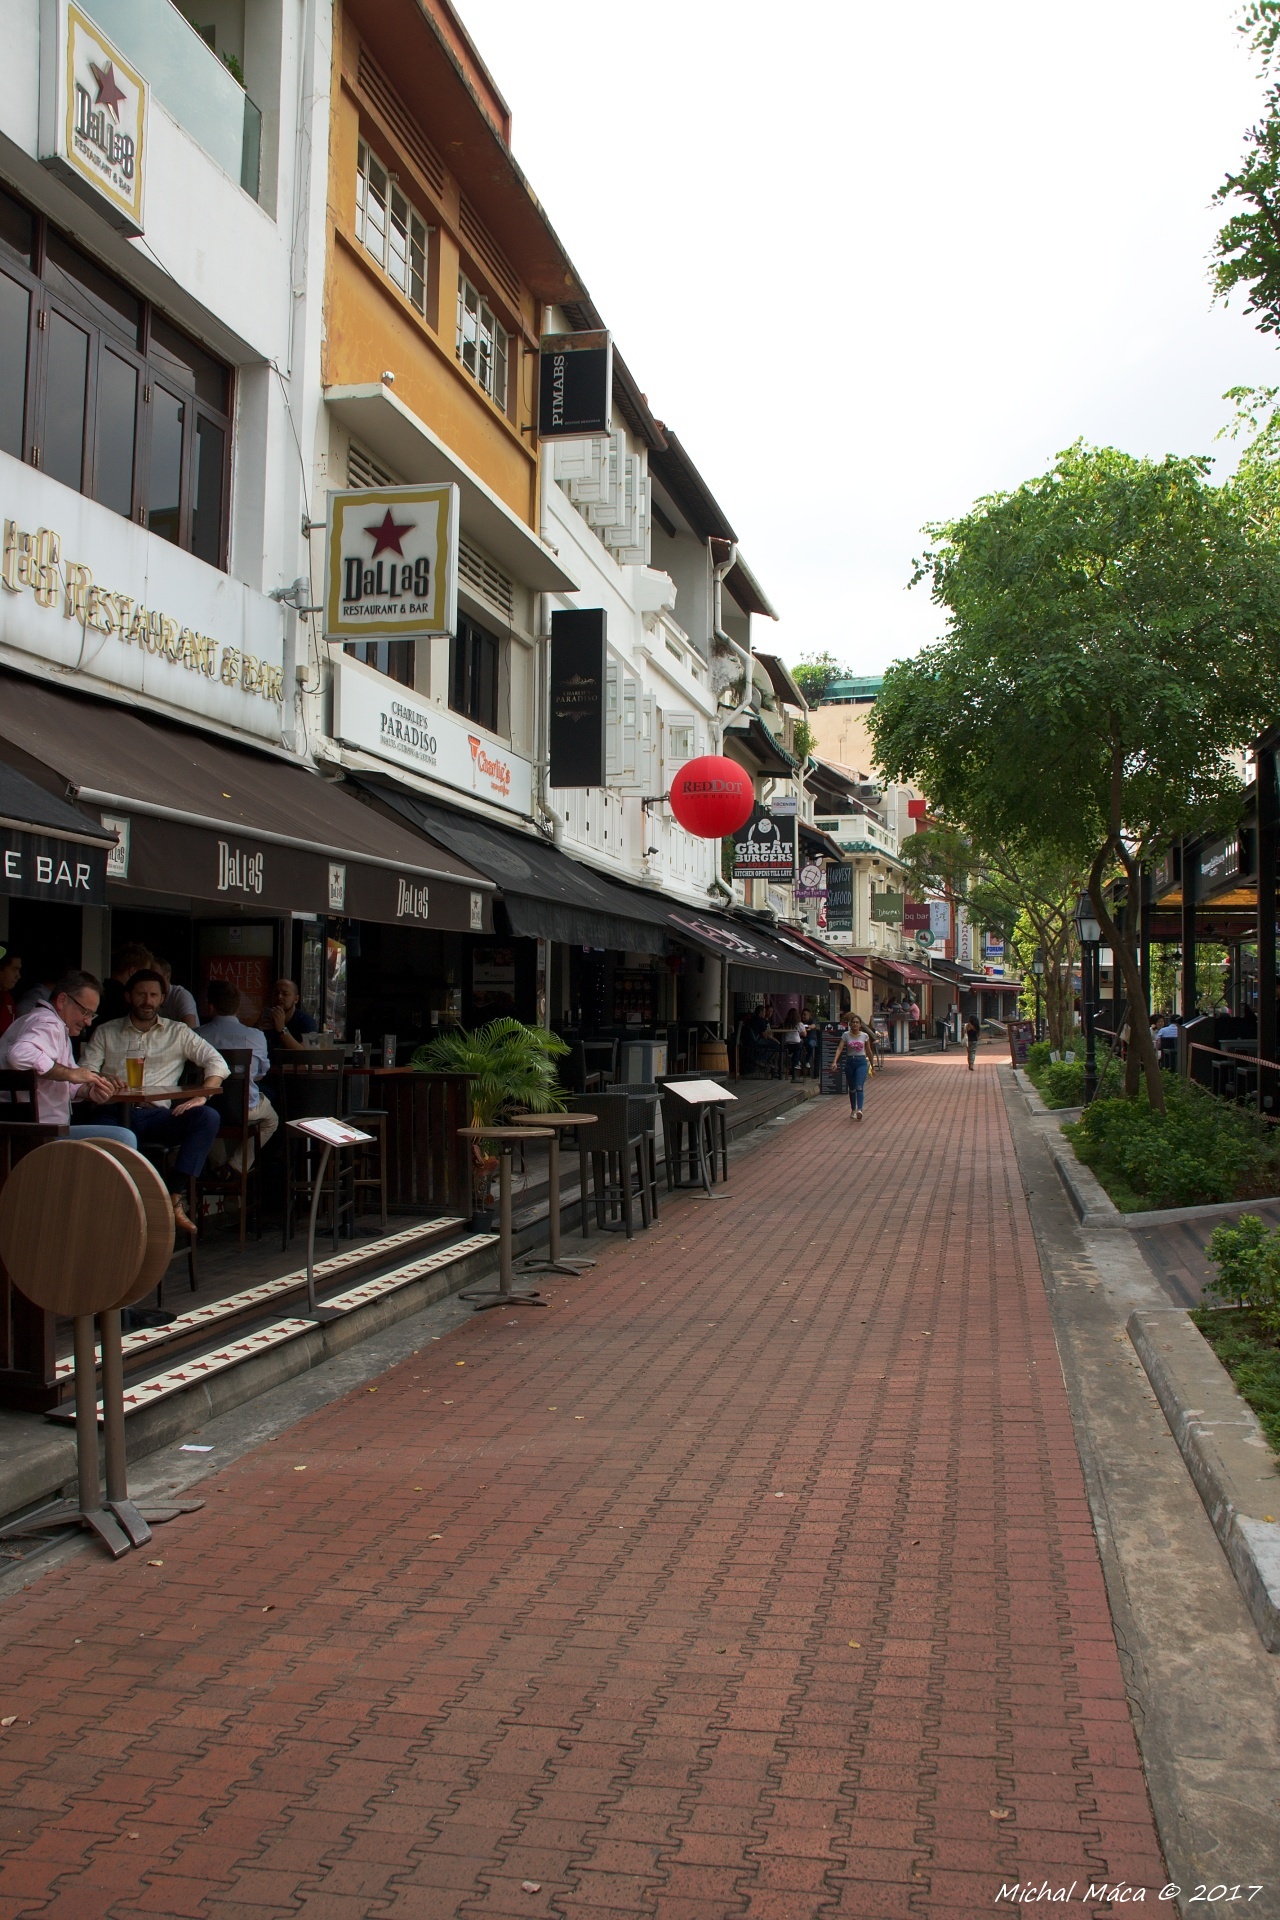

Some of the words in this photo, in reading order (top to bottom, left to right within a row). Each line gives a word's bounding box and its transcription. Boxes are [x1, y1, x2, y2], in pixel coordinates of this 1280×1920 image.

[74, 135, 112, 179] RESTAURANT
[112, 172, 118, 184] &
[118, 176, 132, 196] BAR
[552, 355, 565, 427] PIMABS
[343, 604, 398, 616] RESTAURANT
[400, 605, 406, 614] &
[409, 602, 429, 614] BAR
[63, 559, 219, 680] RESTAURANT
[240, 653, 285, 702] BAR
[555, 695, 598, 703] PARADISO
[391, 701, 429, 730] CHARLIE'S
[380, 712, 437, 755] PARADISO
[734, 841, 793, 854] GREAT
[735, 853, 793, 862] BURGERS
[36, 856, 90, 890] BAR
[781, 869, 793, 877] LATE
[827, 867, 851, 884] HARVEST
[827, 890, 852, 907] SEAFOOD
[209, 961, 262, 976] MATES
